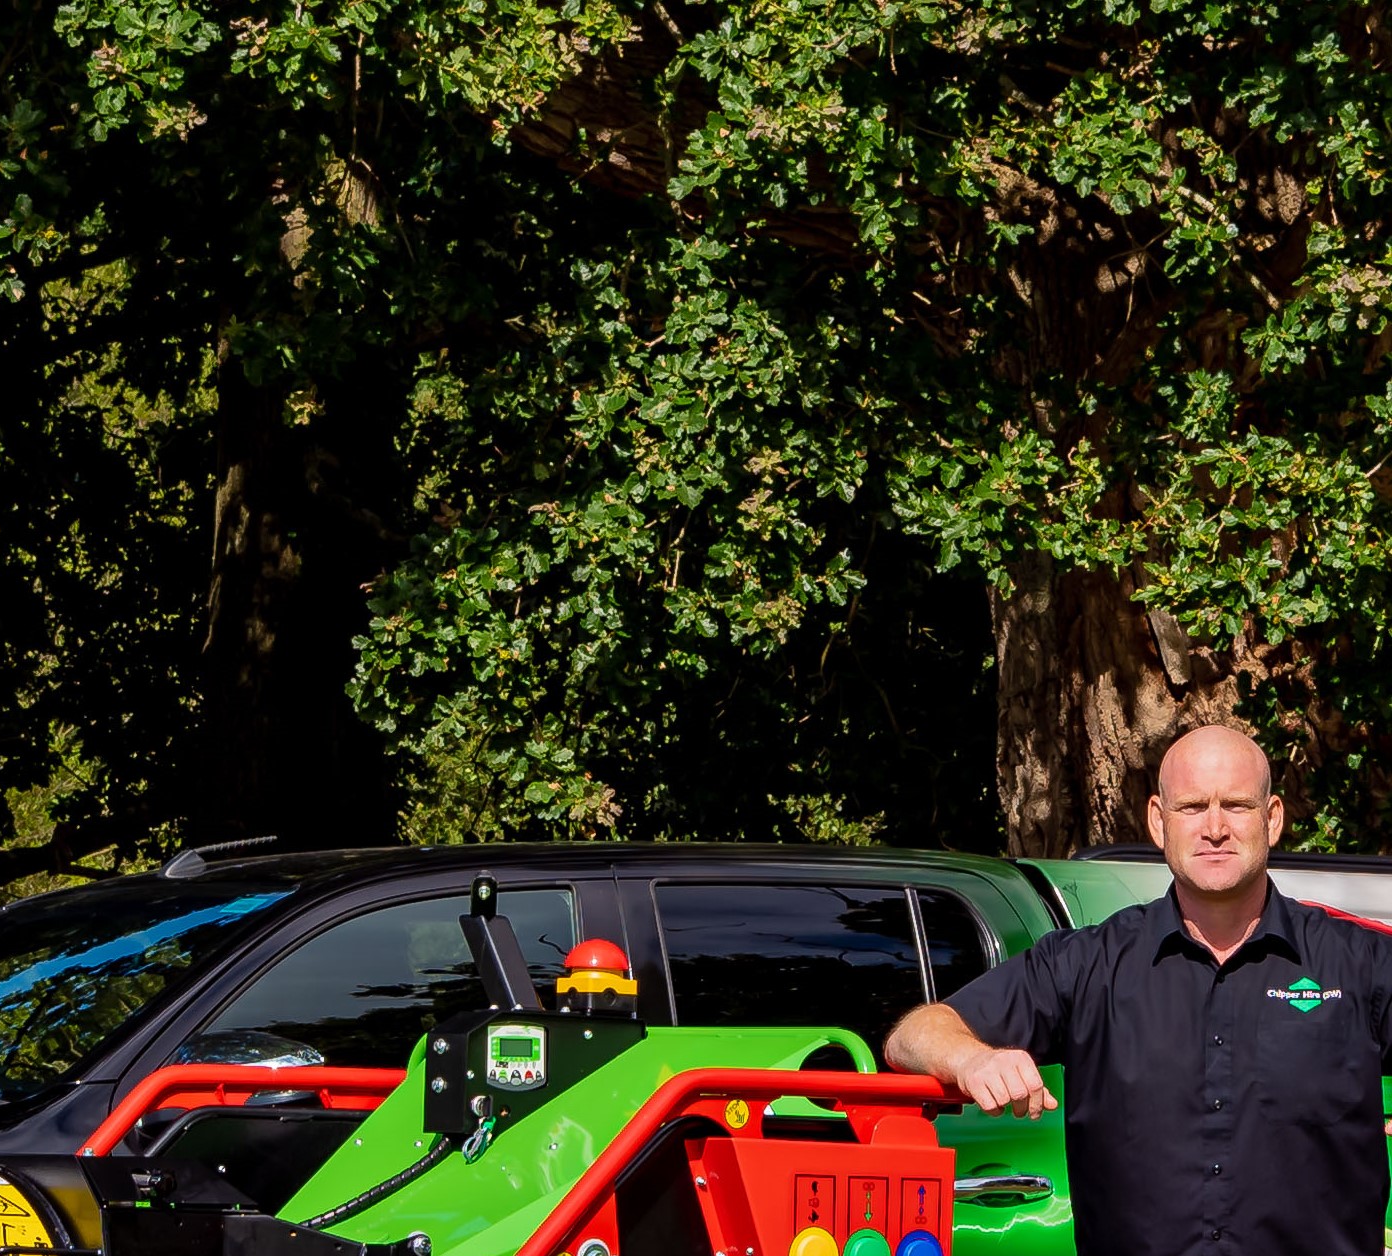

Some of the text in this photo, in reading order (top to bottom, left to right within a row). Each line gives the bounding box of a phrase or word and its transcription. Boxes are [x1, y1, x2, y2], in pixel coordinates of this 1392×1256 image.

[1266, 989, 1342, 1000] Chipper Hire (SW)
